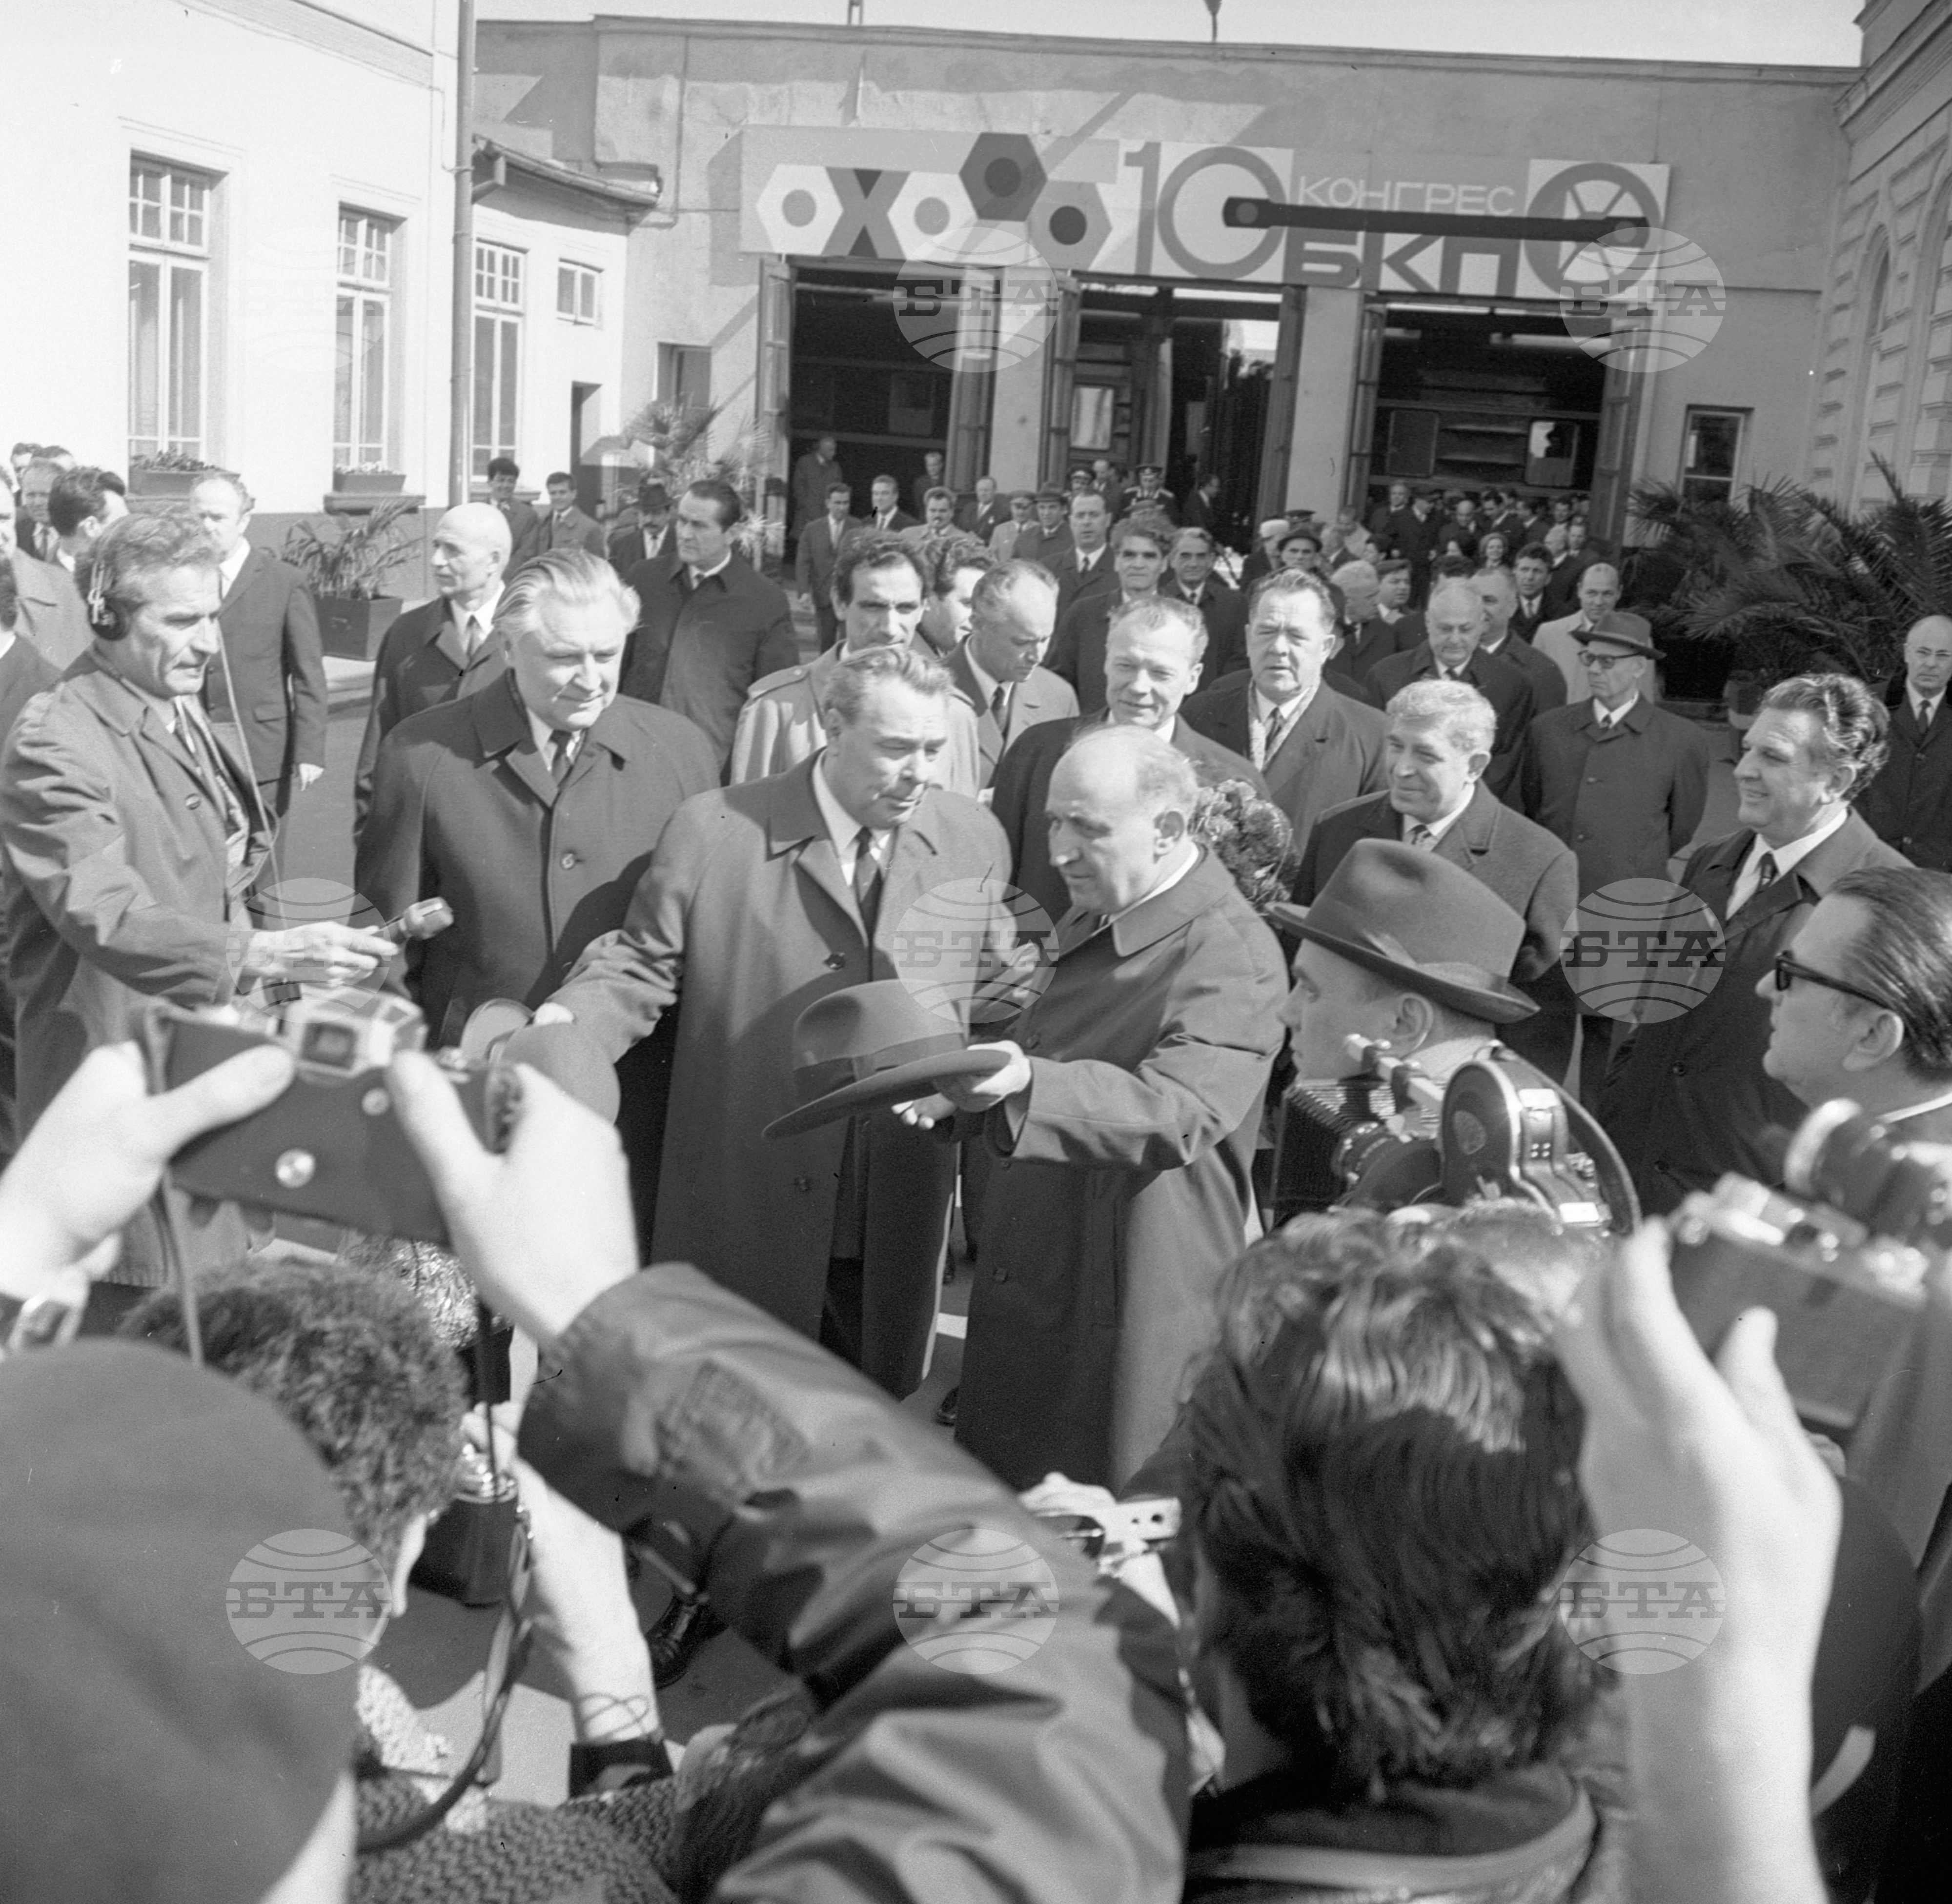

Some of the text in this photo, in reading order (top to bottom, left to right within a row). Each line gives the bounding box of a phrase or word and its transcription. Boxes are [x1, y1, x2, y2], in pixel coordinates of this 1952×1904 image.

[1124, 141, 1514, 280] 10 КОНГРЕС
[1282, 226, 1525, 298] БКП
